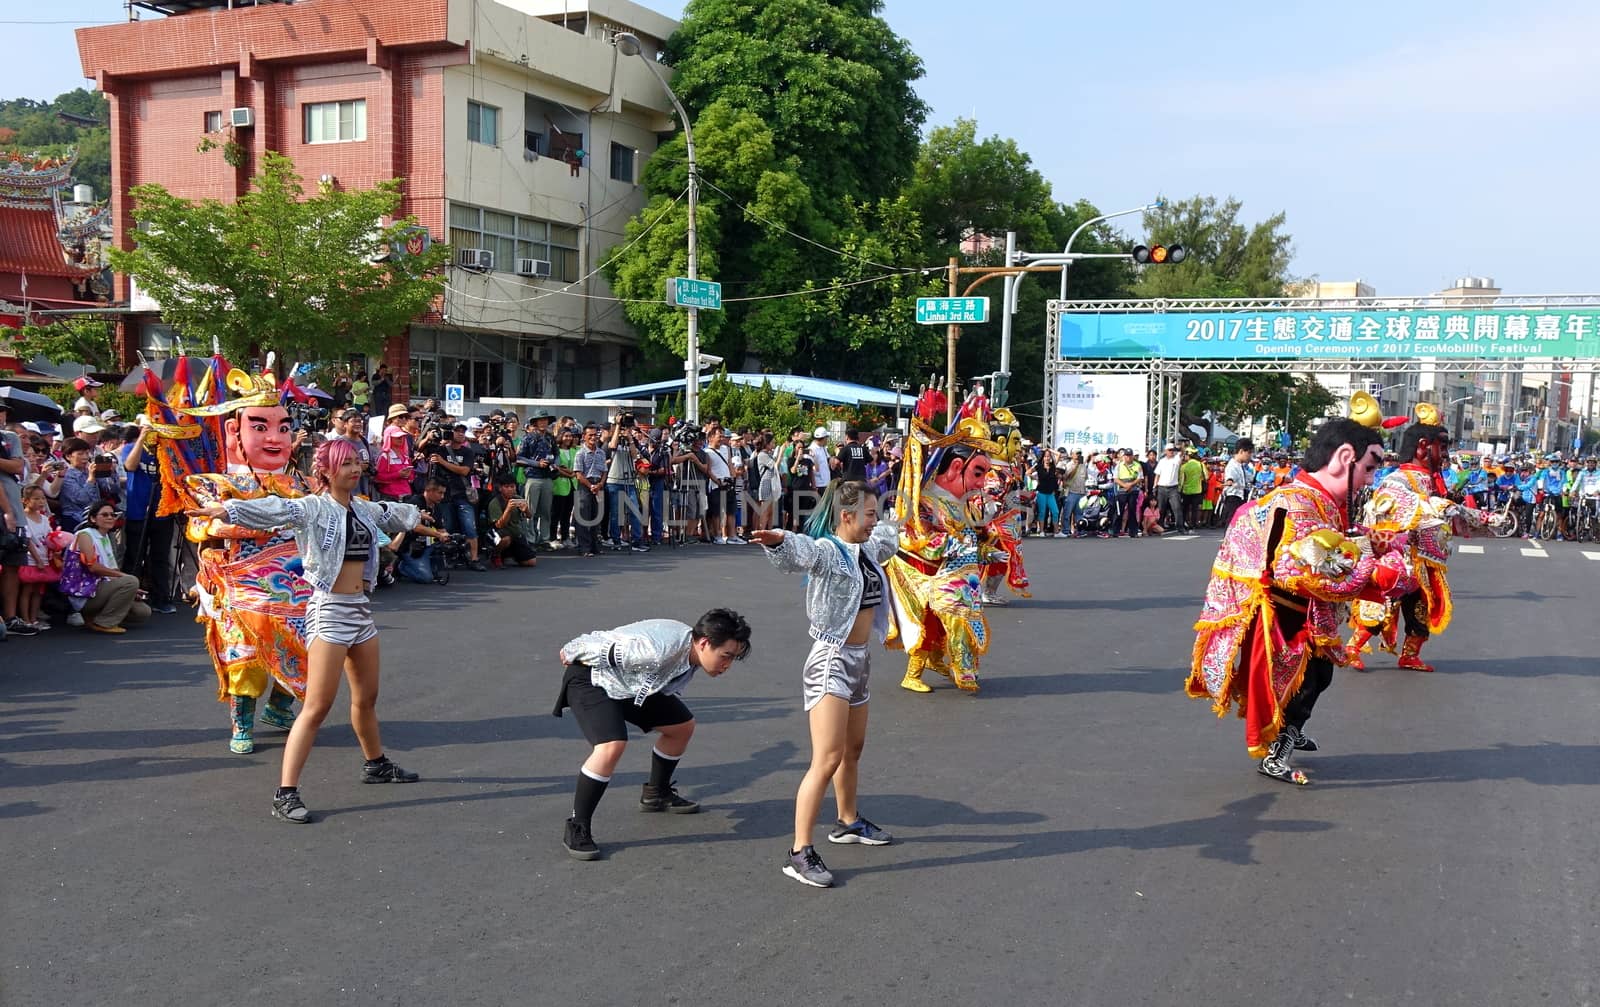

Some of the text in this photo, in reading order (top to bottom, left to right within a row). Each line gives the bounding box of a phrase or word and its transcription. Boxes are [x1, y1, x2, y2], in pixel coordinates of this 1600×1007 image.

[926, 312, 948, 321] Linhai
[950, 312, 962, 321] 3rd
[1186, 315, 1600, 341] 2017生態交通全球盛典開幕嘉年
[1256, 343, 1542, 355] Opening Ceremony of 2017 EcoMobility Festival
